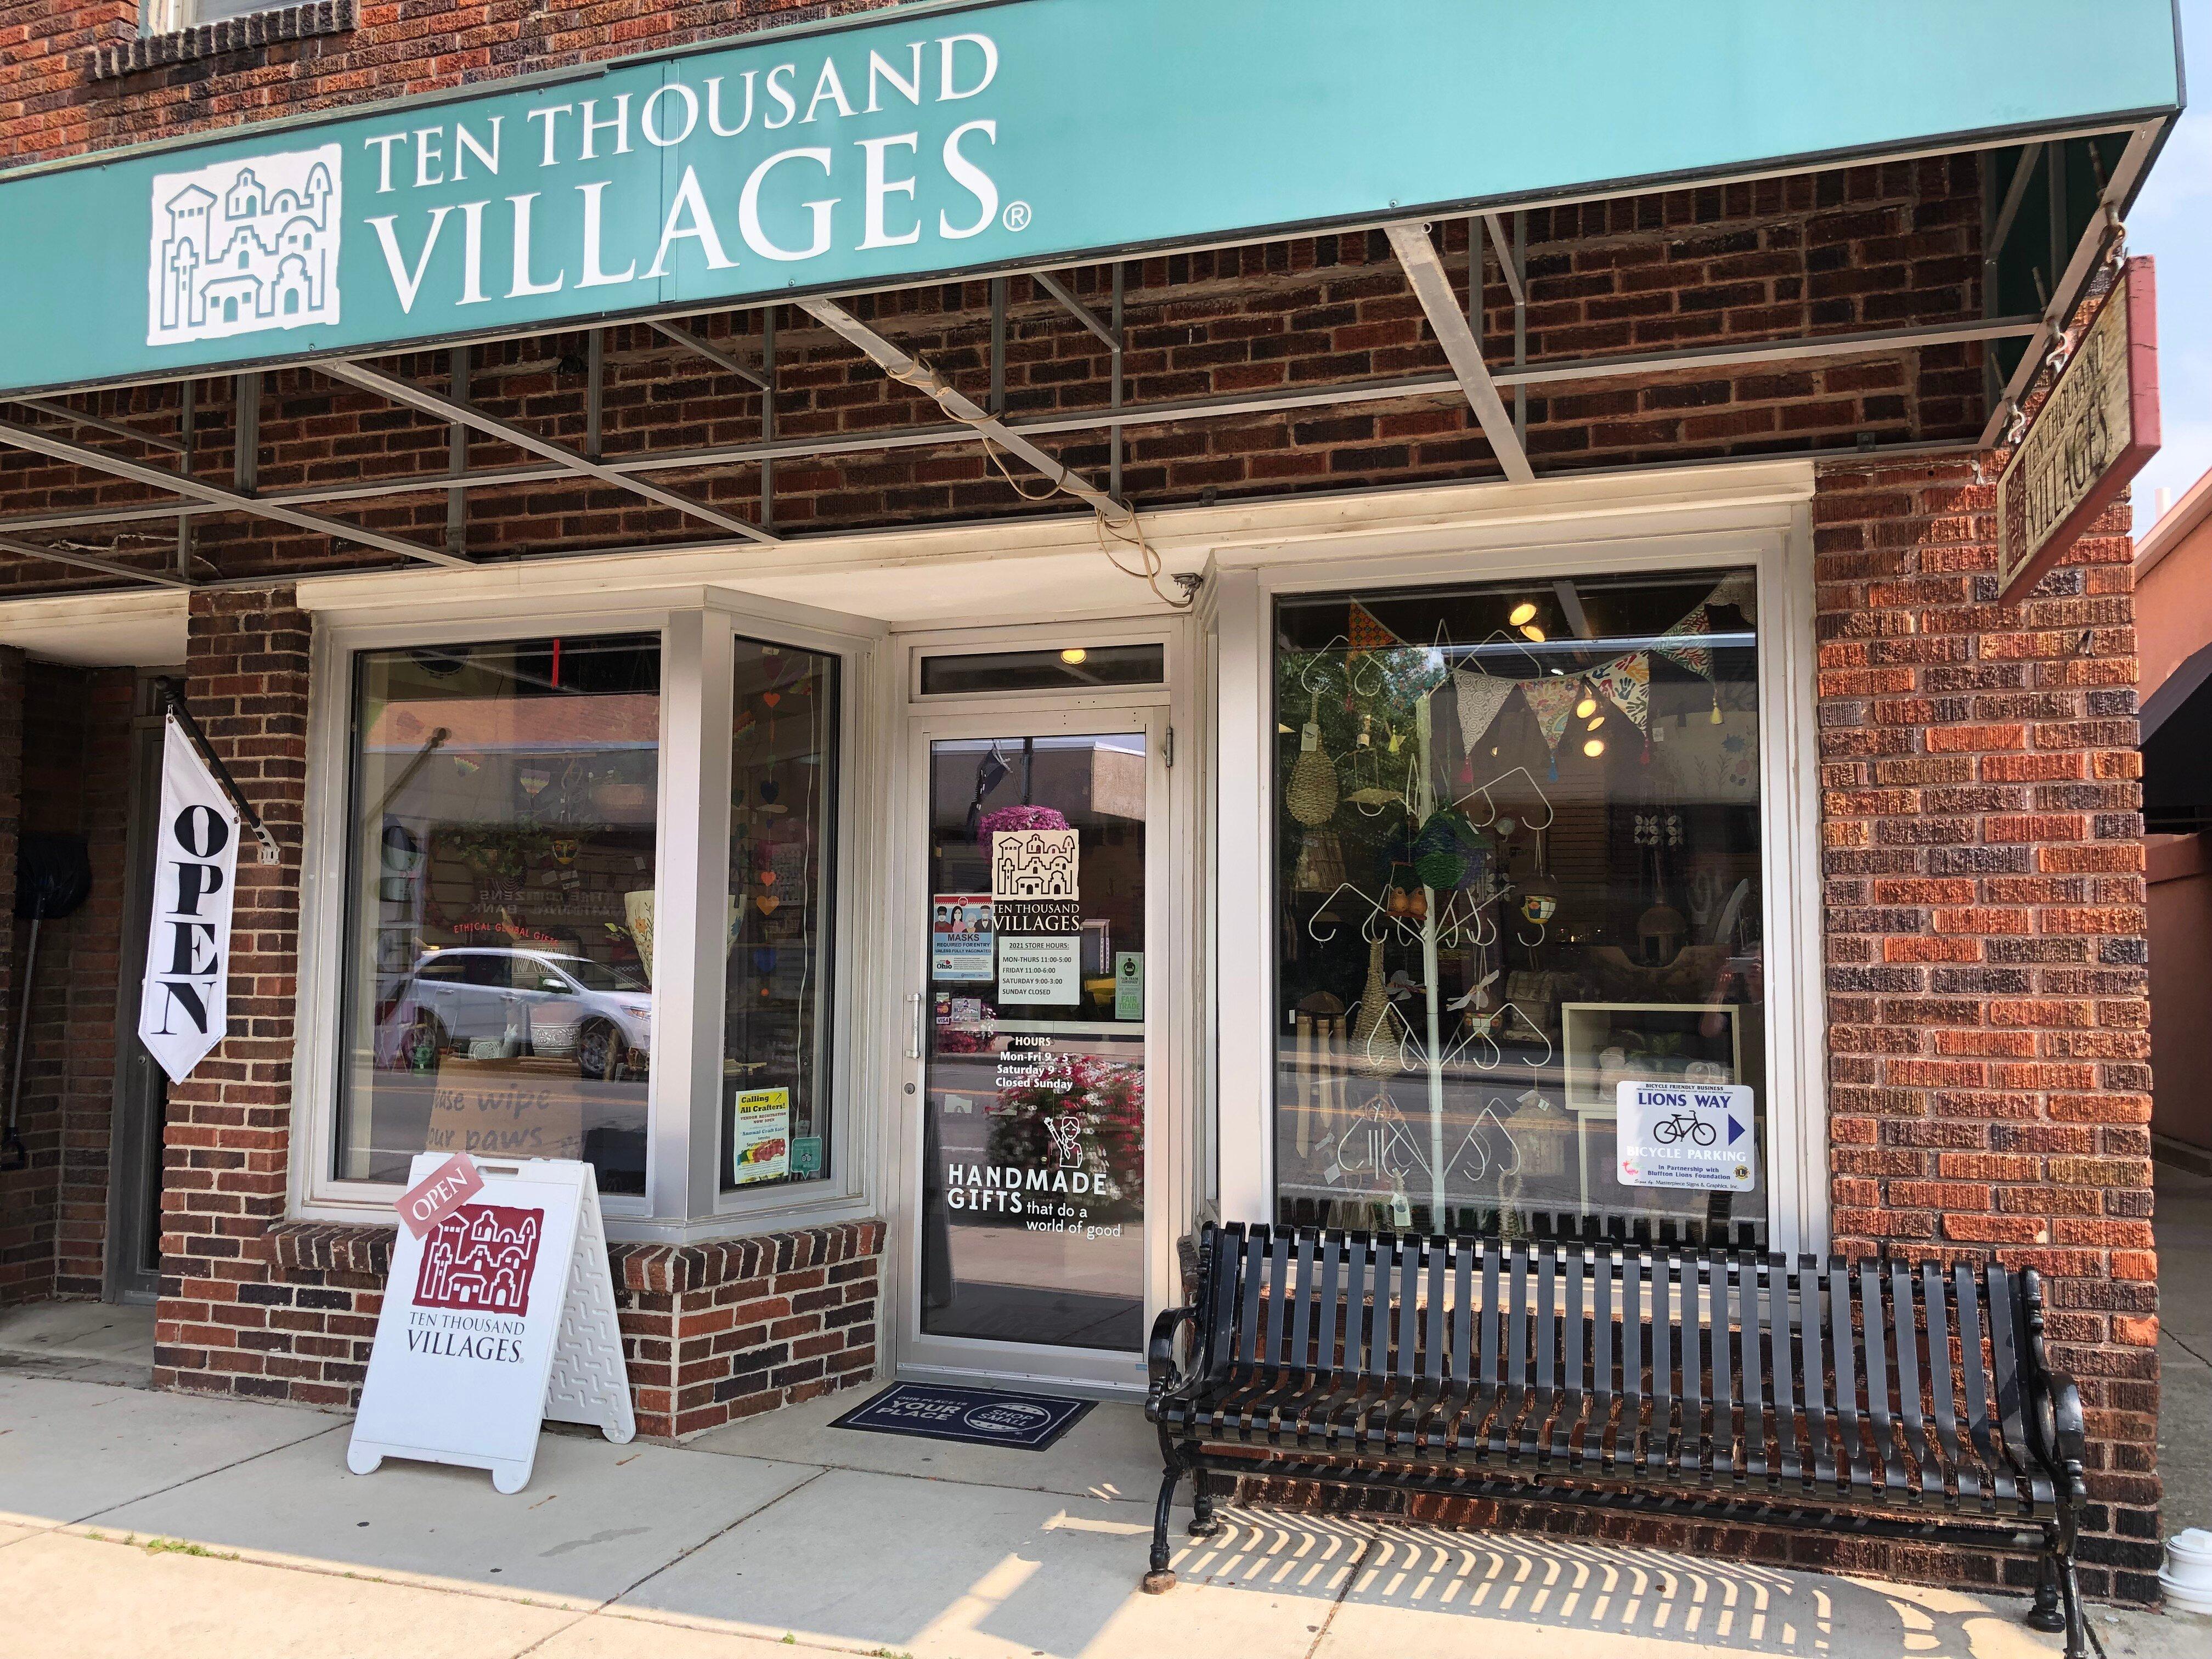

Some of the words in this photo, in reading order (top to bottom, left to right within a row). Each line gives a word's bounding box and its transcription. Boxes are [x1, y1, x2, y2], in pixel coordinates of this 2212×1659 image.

[364, 116, 504, 193] TEN
[528, 32, 998, 167] THOUSAND
[2030, 432, 2043, 475] TEN
[2045, 330, 2105, 447] THOUSAND
[992, 904, 1012, 913] TEN
[1015, 904, 1080, 913] THOUSAND
[151, 805, 228, 1035] OPEN
[454, 922, 490, 934] ETHICAL
[1015, 1036, 1051, 1046] HOURS
[1000, 1051, 1041, 1062] Mon-Fri
[1045, 1052, 1052, 1062] 9
[1062, 1053, 1069, 1062] 5
[997, 1064, 1045, 1077] Saturday
[1048, 1065, 1054, 1075] 9
[1065, 1066, 1072, 1075] 3
[995, 1077, 1030, 1087] Closed
[1034, 1078, 1073, 1092] Sunday
[478, 1083, 549, 1119] wipe
[753, 1103, 785, 1112] Crafters!
[1639, 1092, 1686, 1107] LIONS
[1694, 1094, 1731, 1108] WAY
[466, 1126, 543, 1150] paws
[1627, 1146, 1681, 1159] BICYCLE
[1688, 1149, 1746, 1162] PARKING
[948, 1163, 1107, 1195] HANDMADE
[412, 1167, 470, 1222] OPEN
[947, 1187, 1023, 1214] GIFTS
[1026, 1200, 1053, 1216] that
[1058, 1203, 1075, 1217] do
[1079, 1208, 1088, 1218] a
[1026, 1218, 1064, 1233] world
[1068, 1220, 1083, 1234] of
[1087, 1223, 1121, 1240] good
[410, 1312, 438, 1327] TEN
[442, 1314, 525, 1335] THOUSAND
[876, 1407, 952, 1420] PLACE
[891, 1401, 961, 1414] YOUR
[990, 1409, 1034, 1420] SHOP
[978, 1413, 1027, 1426] SMALL
